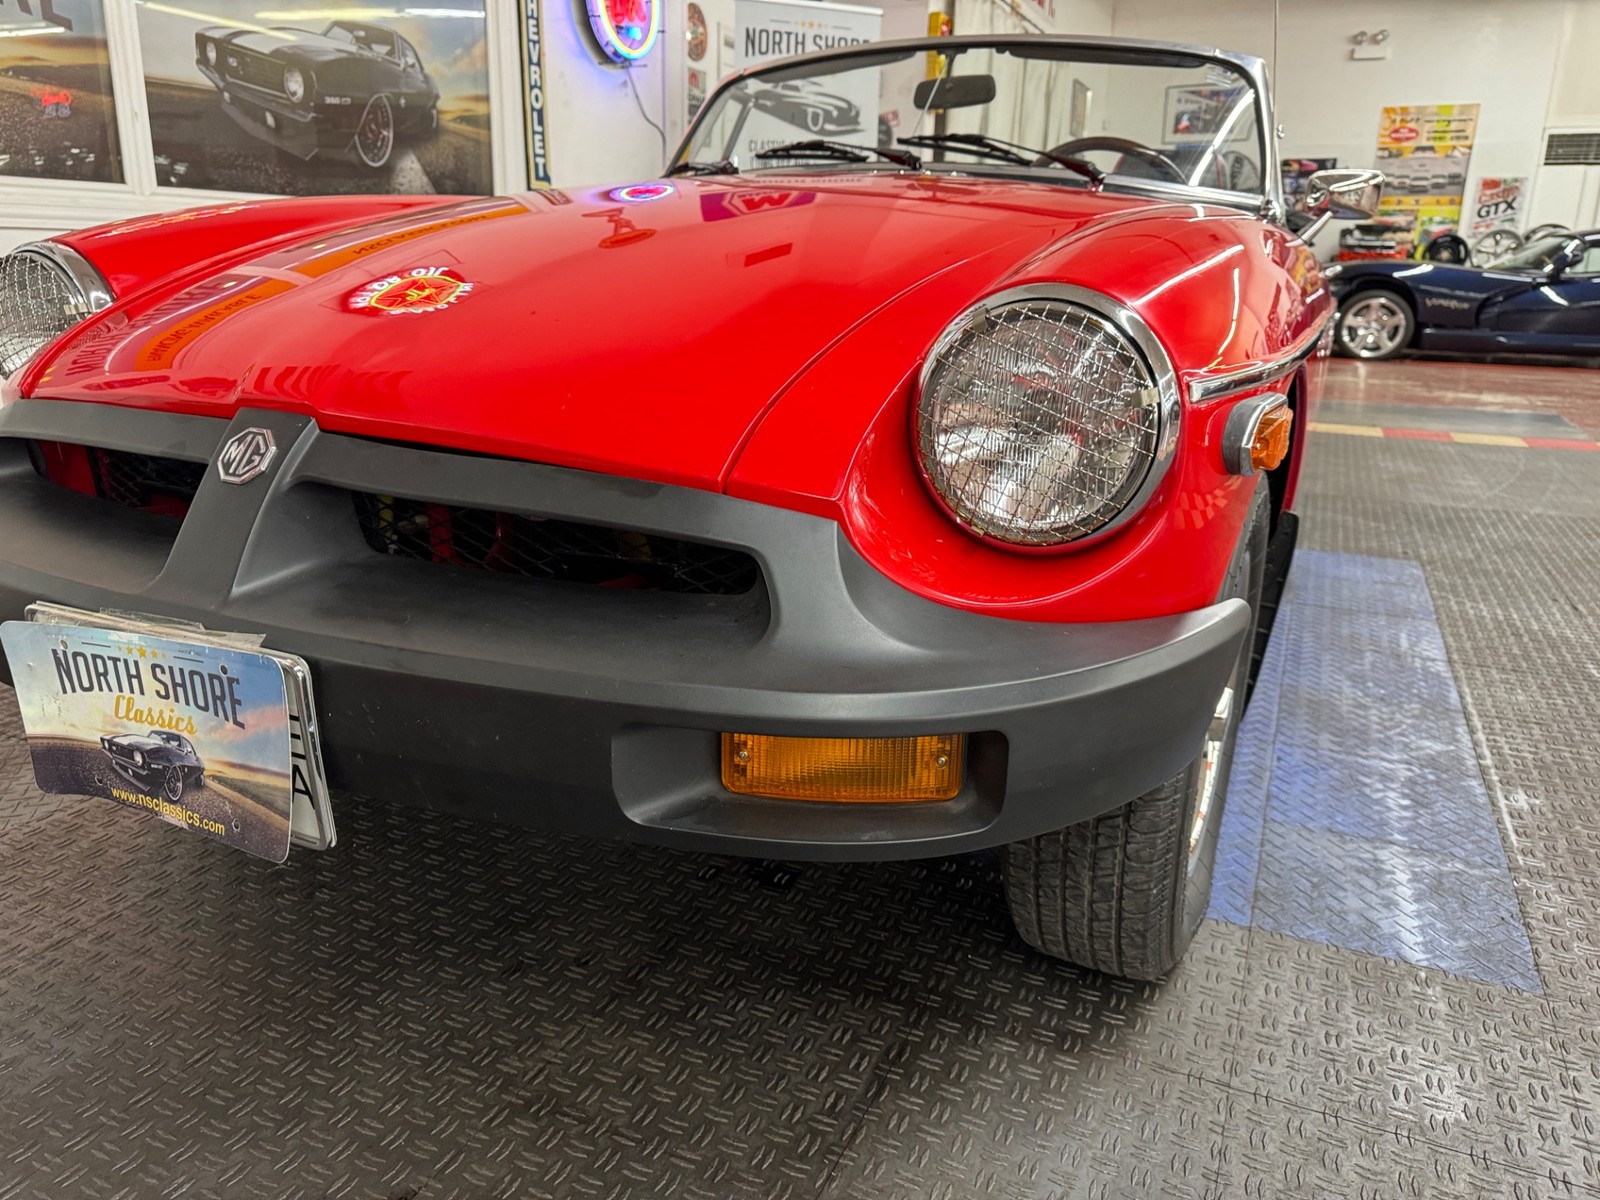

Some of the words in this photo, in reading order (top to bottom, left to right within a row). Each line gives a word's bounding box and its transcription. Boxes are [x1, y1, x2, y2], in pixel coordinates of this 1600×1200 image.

[745, 26, 806, 58] NORTH
[1477, 196, 1517, 219] GTX
[223, 434, 267, 475] MG
[51, 648, 145, 696] NORTH
[150, 662, 246, 730] SHORE
[114, 694, 198, 736] Classics
[111, 787, 226, 836] www.nsclassics.com
